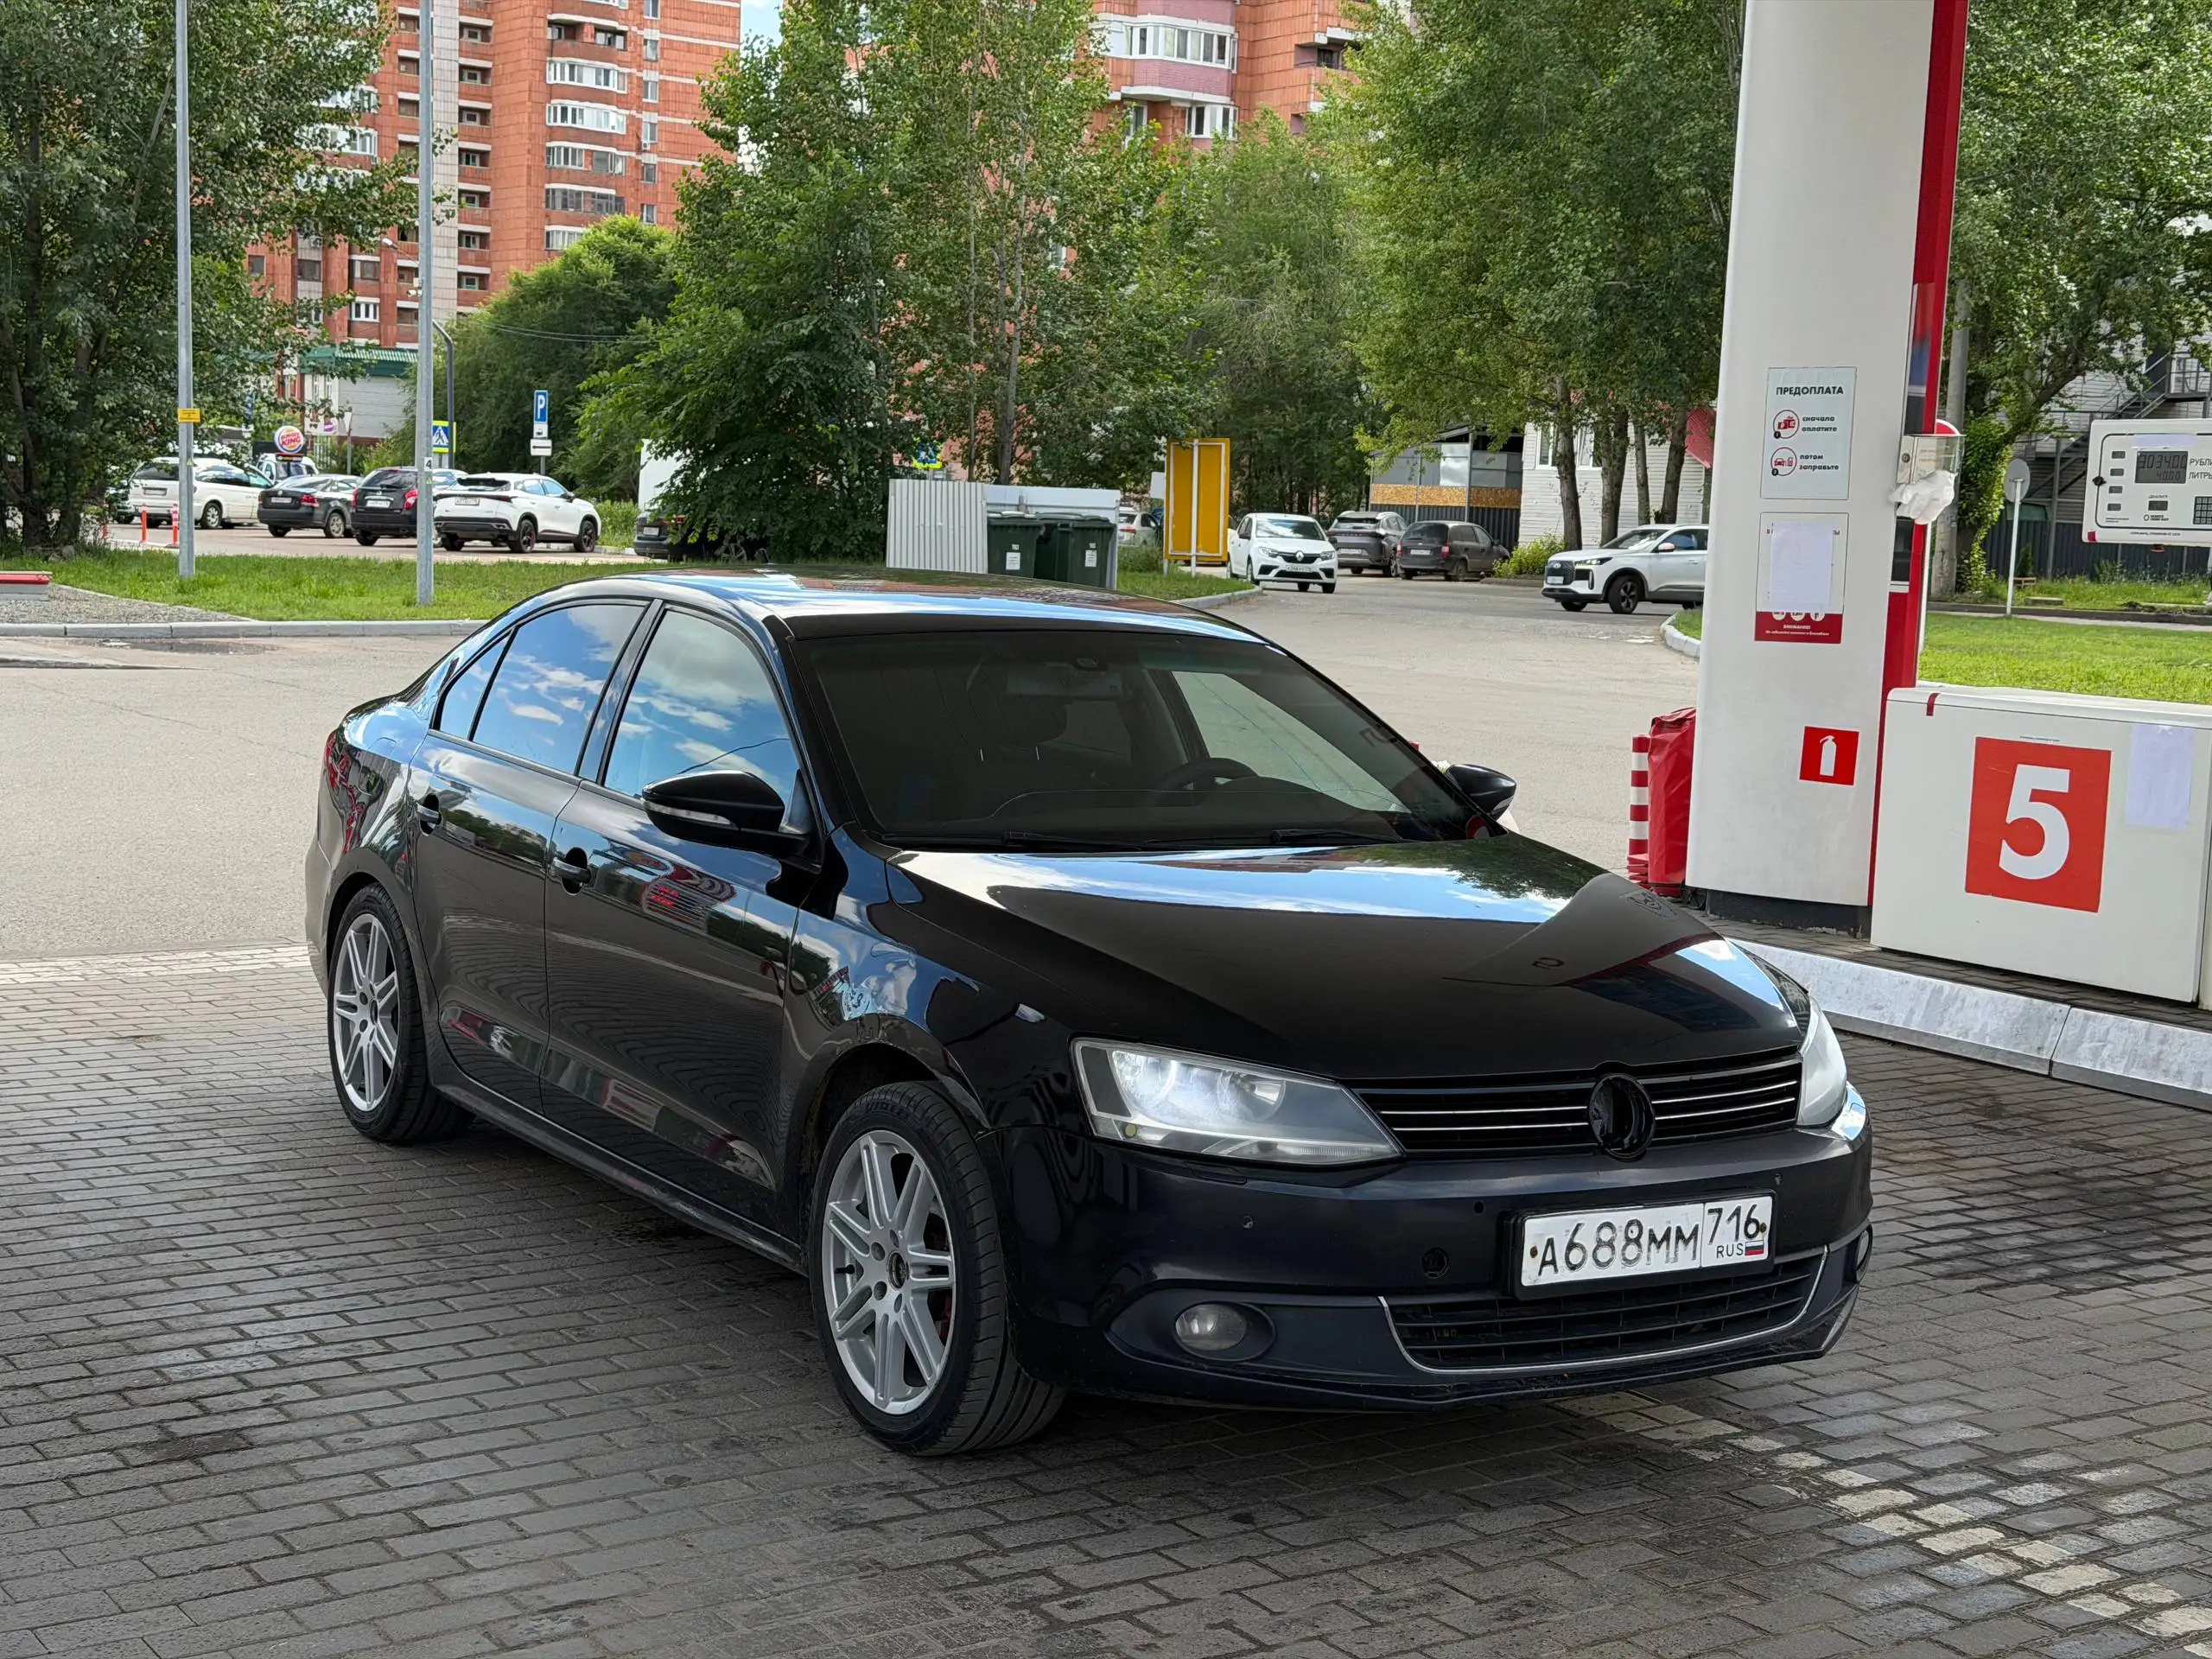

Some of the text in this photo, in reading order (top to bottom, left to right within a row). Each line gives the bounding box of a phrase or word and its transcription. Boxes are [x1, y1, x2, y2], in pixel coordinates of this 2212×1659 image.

[1776, 386, 1844, 397] ПРЕДОПЛАТА
[537, 395, 546, 419] P
[281, 437, 302, 446] KING
[425, 460, 432, 470] 4
[1999, 764, 2070, 880] 5
[1538, 1204, 1761, 1277] А688ММ 716
[1716, 1244, 1745, 1259] RUS
